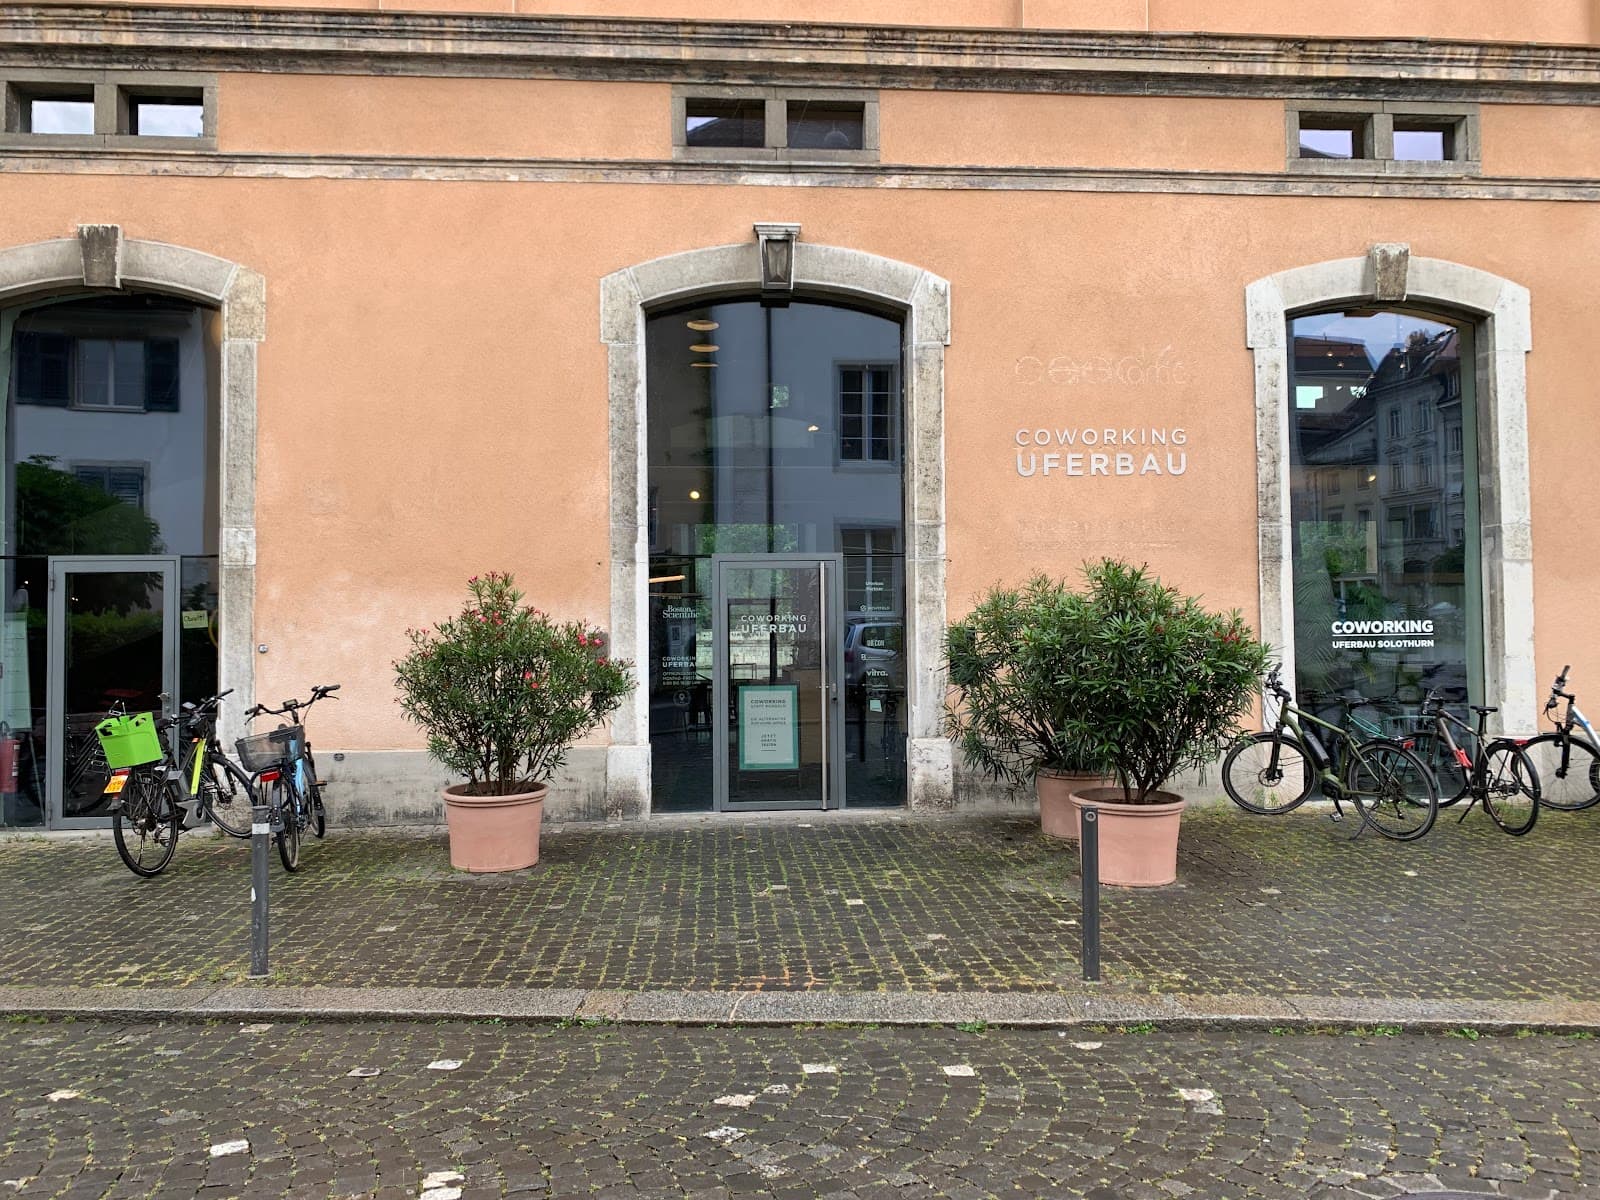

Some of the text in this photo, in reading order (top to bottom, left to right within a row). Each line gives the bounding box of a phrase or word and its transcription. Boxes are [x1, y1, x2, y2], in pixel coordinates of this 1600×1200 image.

[1015, 428, 1188, 446] COWORKING
[1016, 452, 1188, 477] UFERBAU
[667, 604, 692, 613] Boston
[662, 609, 700, 619] Scientific
[741, 614, 807, 622] COWORKING
[741, 623, 807, 633] UFERBAU
[1331, 620, 1434, 634] COWORKING
[1332, 640, 1434, 649] UFERBAU SOLOTHURN
